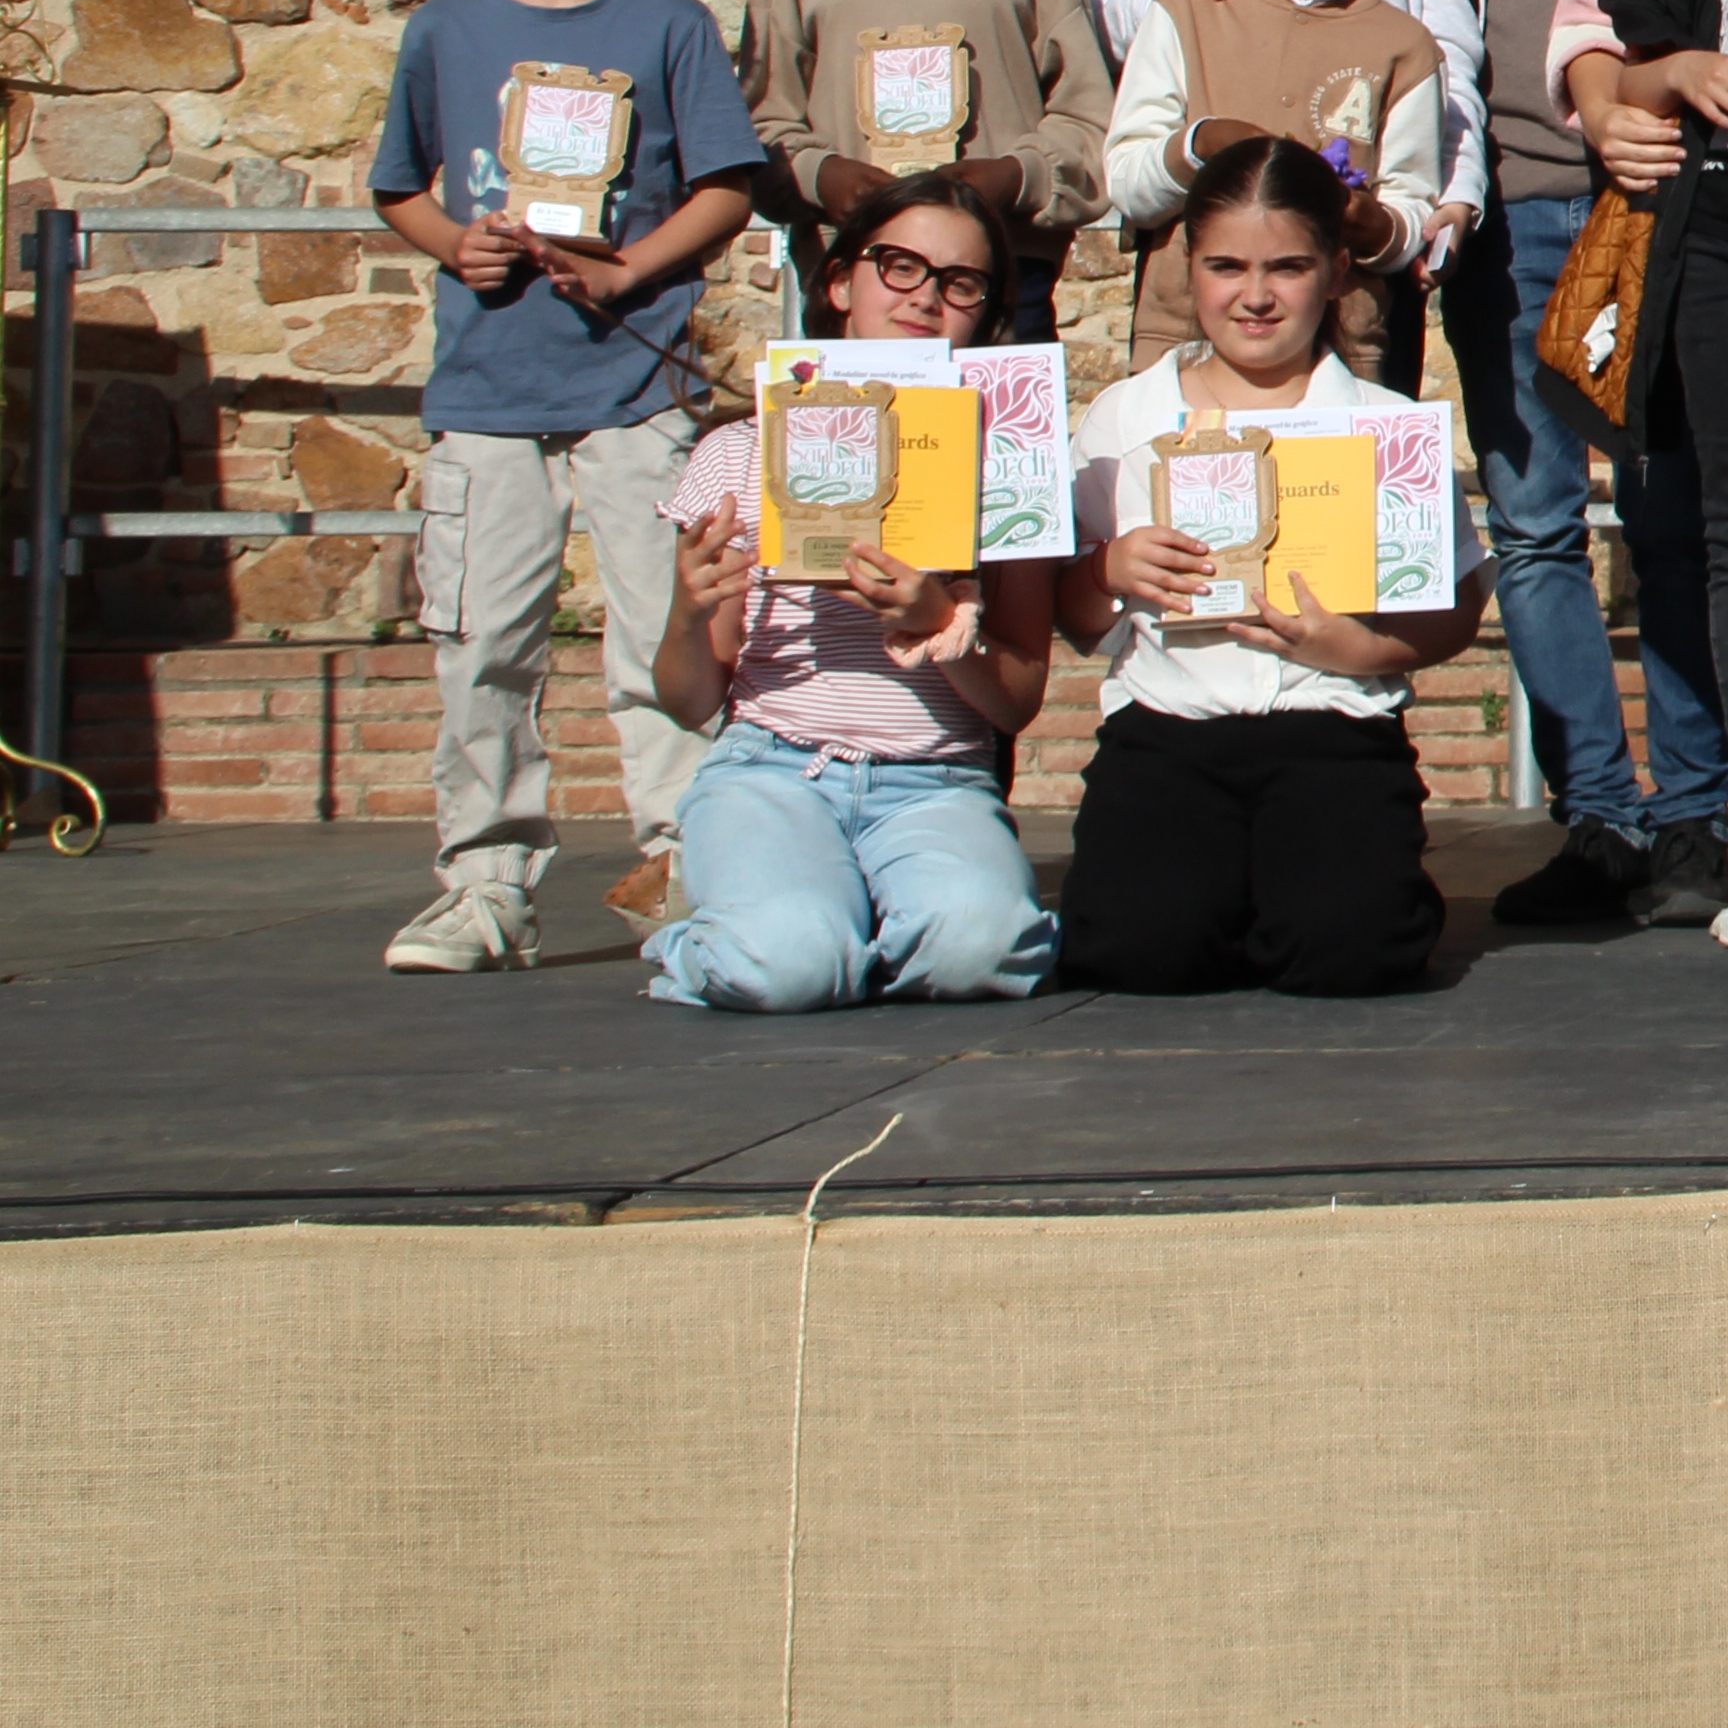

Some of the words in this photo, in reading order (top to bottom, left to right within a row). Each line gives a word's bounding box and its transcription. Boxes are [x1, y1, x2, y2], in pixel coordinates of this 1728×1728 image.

[1327, 67, 1362, 84] STATE
[1324, 77, 1373, 141] A
[984, 447, 1048, 480] ordi
[1277, 480, 1340, 502] guards
[1378, 502, 1433, 532] ordi
